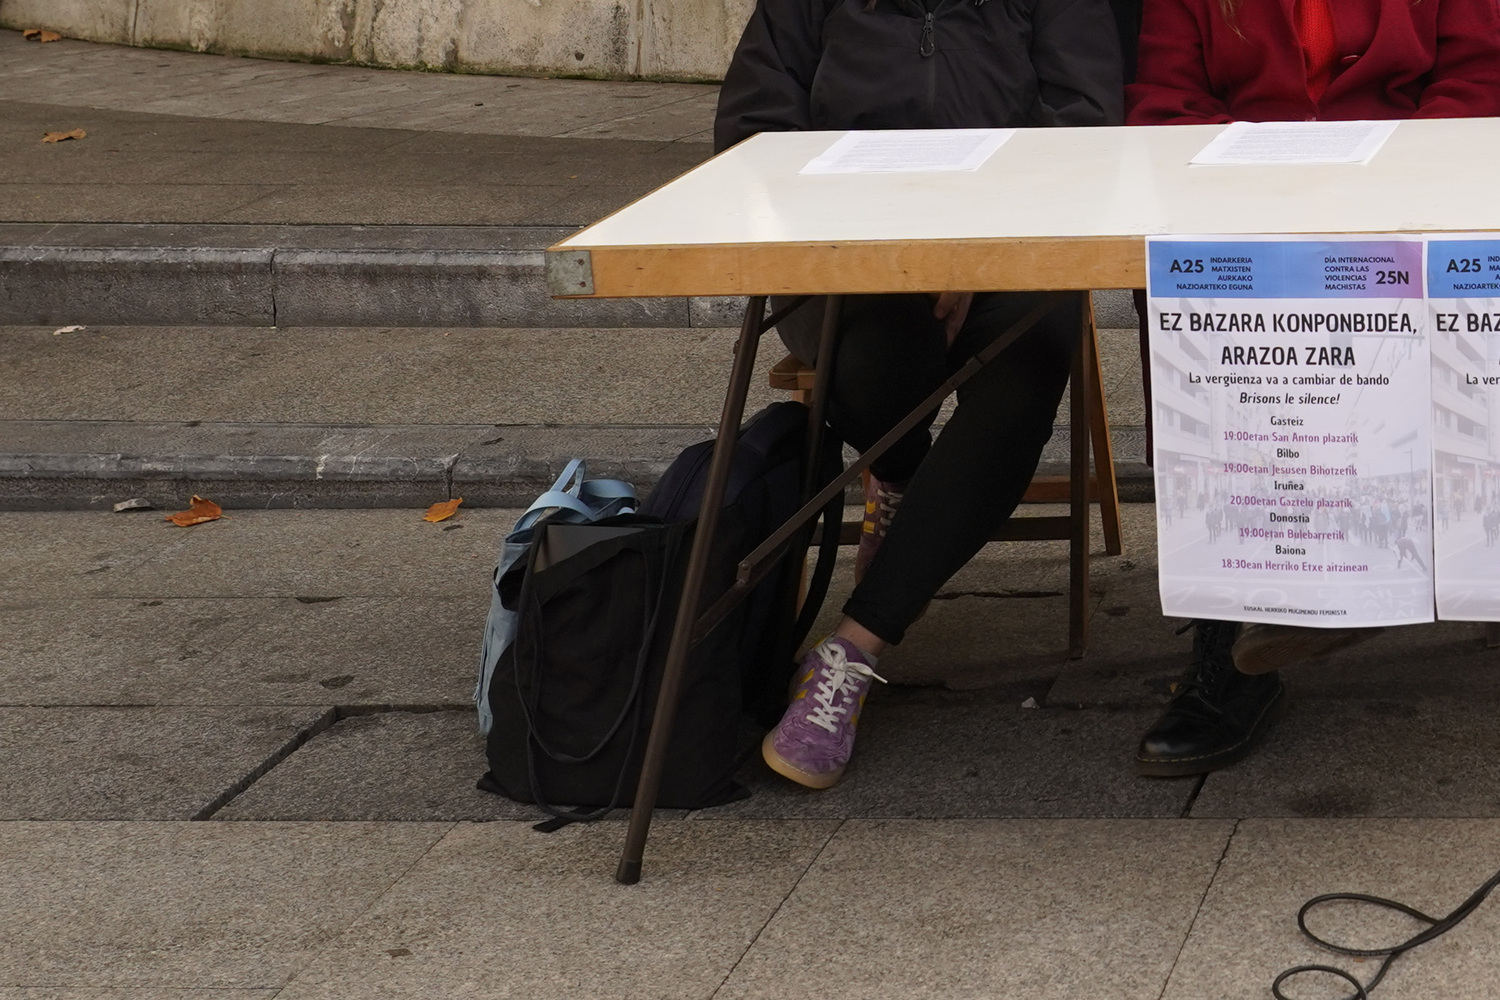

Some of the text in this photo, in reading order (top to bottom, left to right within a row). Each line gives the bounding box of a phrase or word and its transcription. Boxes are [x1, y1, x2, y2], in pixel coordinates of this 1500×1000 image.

[1170, 259, 1204, 273] A25
[1324, 256, 1337, 264] DÍA
[1446, 258, 1481, 273] A25
[1324, 265, 1369, 273] CONTRA LAS
[1324, 274, 1367, 282] VIOLENCIAS
[1375, 270, 1409, 285] 25N
[1176, 283, 1253, 291] NAZIOARTEKO EGUNA
[1324, 283, 1366, 291] MACHISTAS
[1159, 312, 1417, 335] EZ BAZARA KONPONBIDEA,
[1436, 313, 1459, 332] EZ
[1221, 346, 1356, 366] ARAZOA ZARA
[1189, 372, 1389, 387] La vergüenza va a cambiar de bando
[1466, 373, 1478, 385] La
[1240, 392, 1340, 405] Brisons le silence!
[1270, 416, 1304, 426] Gasteiz
[1224, 432, 1359, 445] 19:00etan San Anton plazatik
[1276, 448, 1300, 459] Bilbo
[1224, 464, 1358, 476] 19:00etan Jesusen Bihotzetik
[1274, 480, 1304, 491] Iruñea
[1230, 496, 1353, 509] 20:00etan Gaztelu plazatik
[1269, 513, 1310, 523] Donostia
[1240, 528, 1345, 540] 19:00etan Bulebarretik
[1275, 545, 1306, 555] Baiona
[1222, 559, 1368, 572] 18:30ean Herriko Etxe aitzinean
